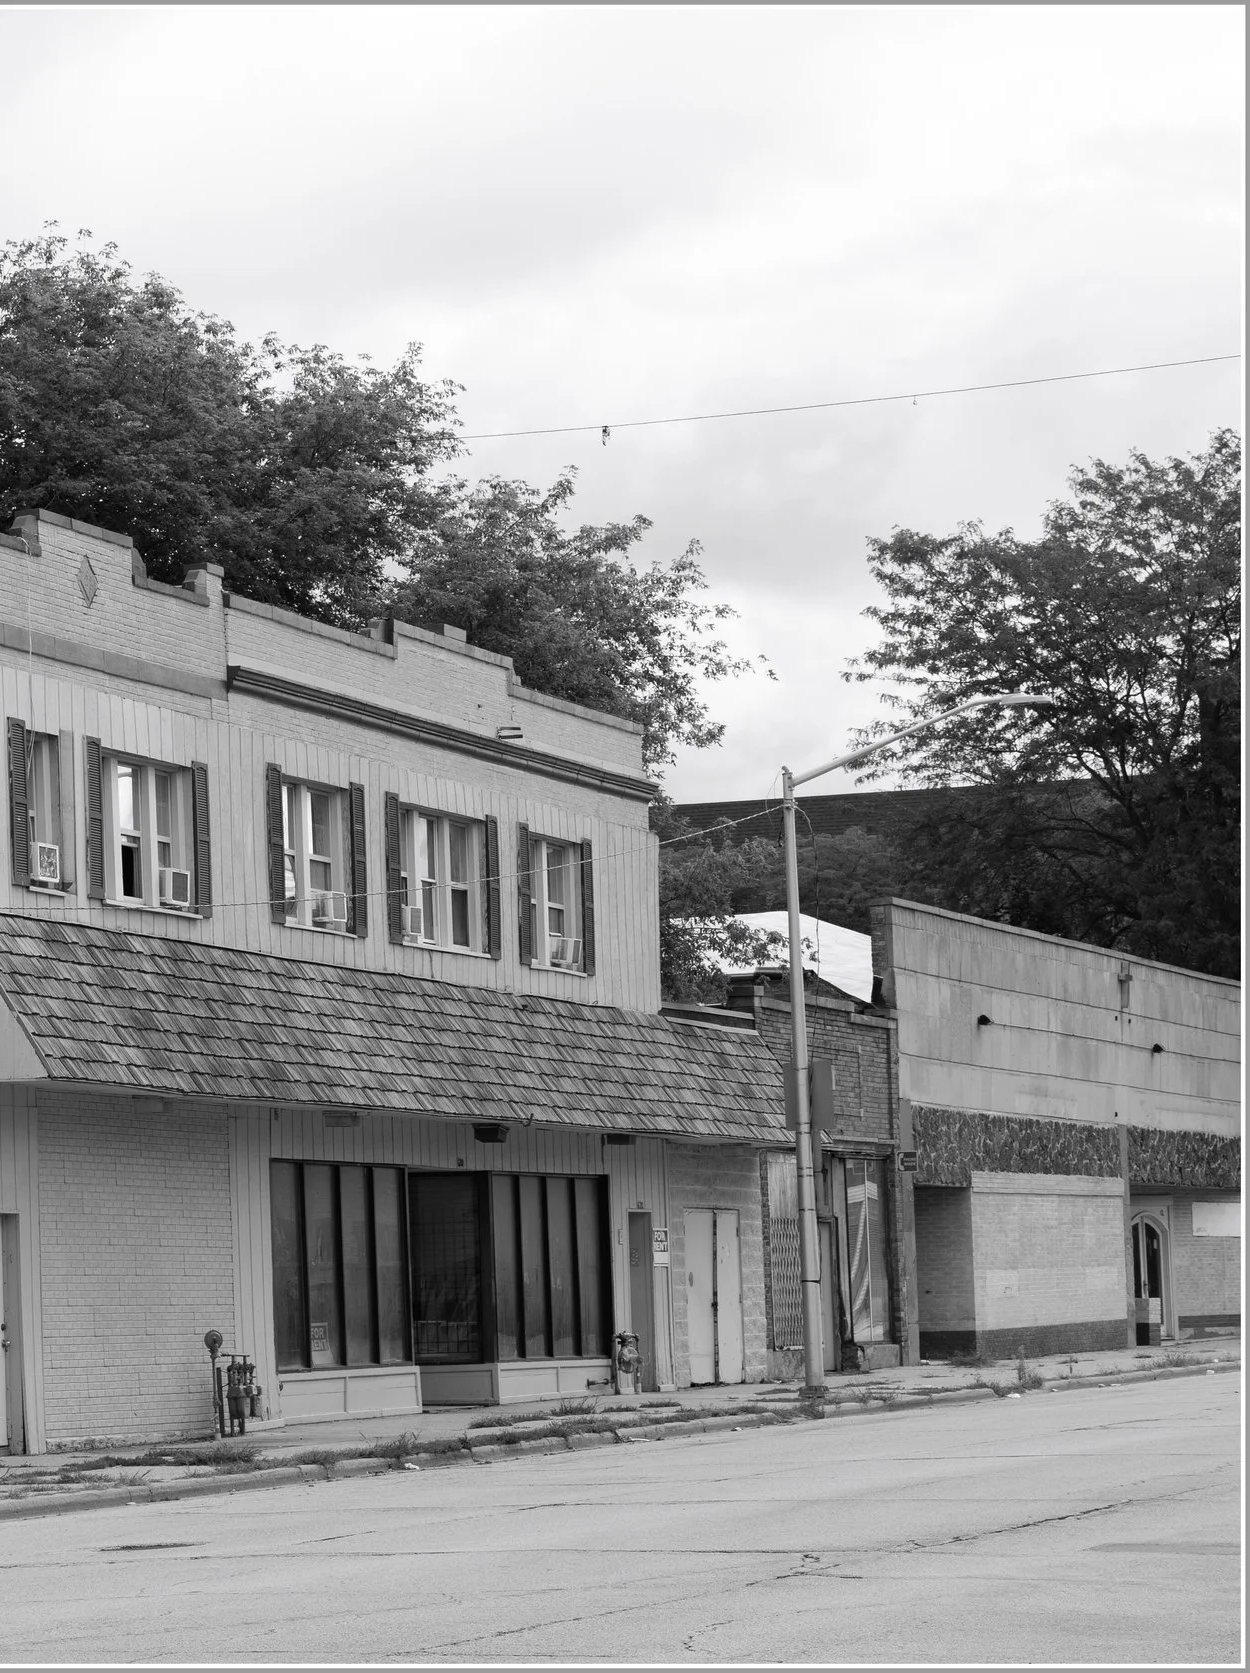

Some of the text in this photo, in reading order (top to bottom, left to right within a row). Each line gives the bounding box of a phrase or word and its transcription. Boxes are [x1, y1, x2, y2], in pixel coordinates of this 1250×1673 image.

[654, 1231, 666, 1241] FOR
[653, 1241, 668, 1251] RENT
[311, 1327, 325, 1339] FOR
